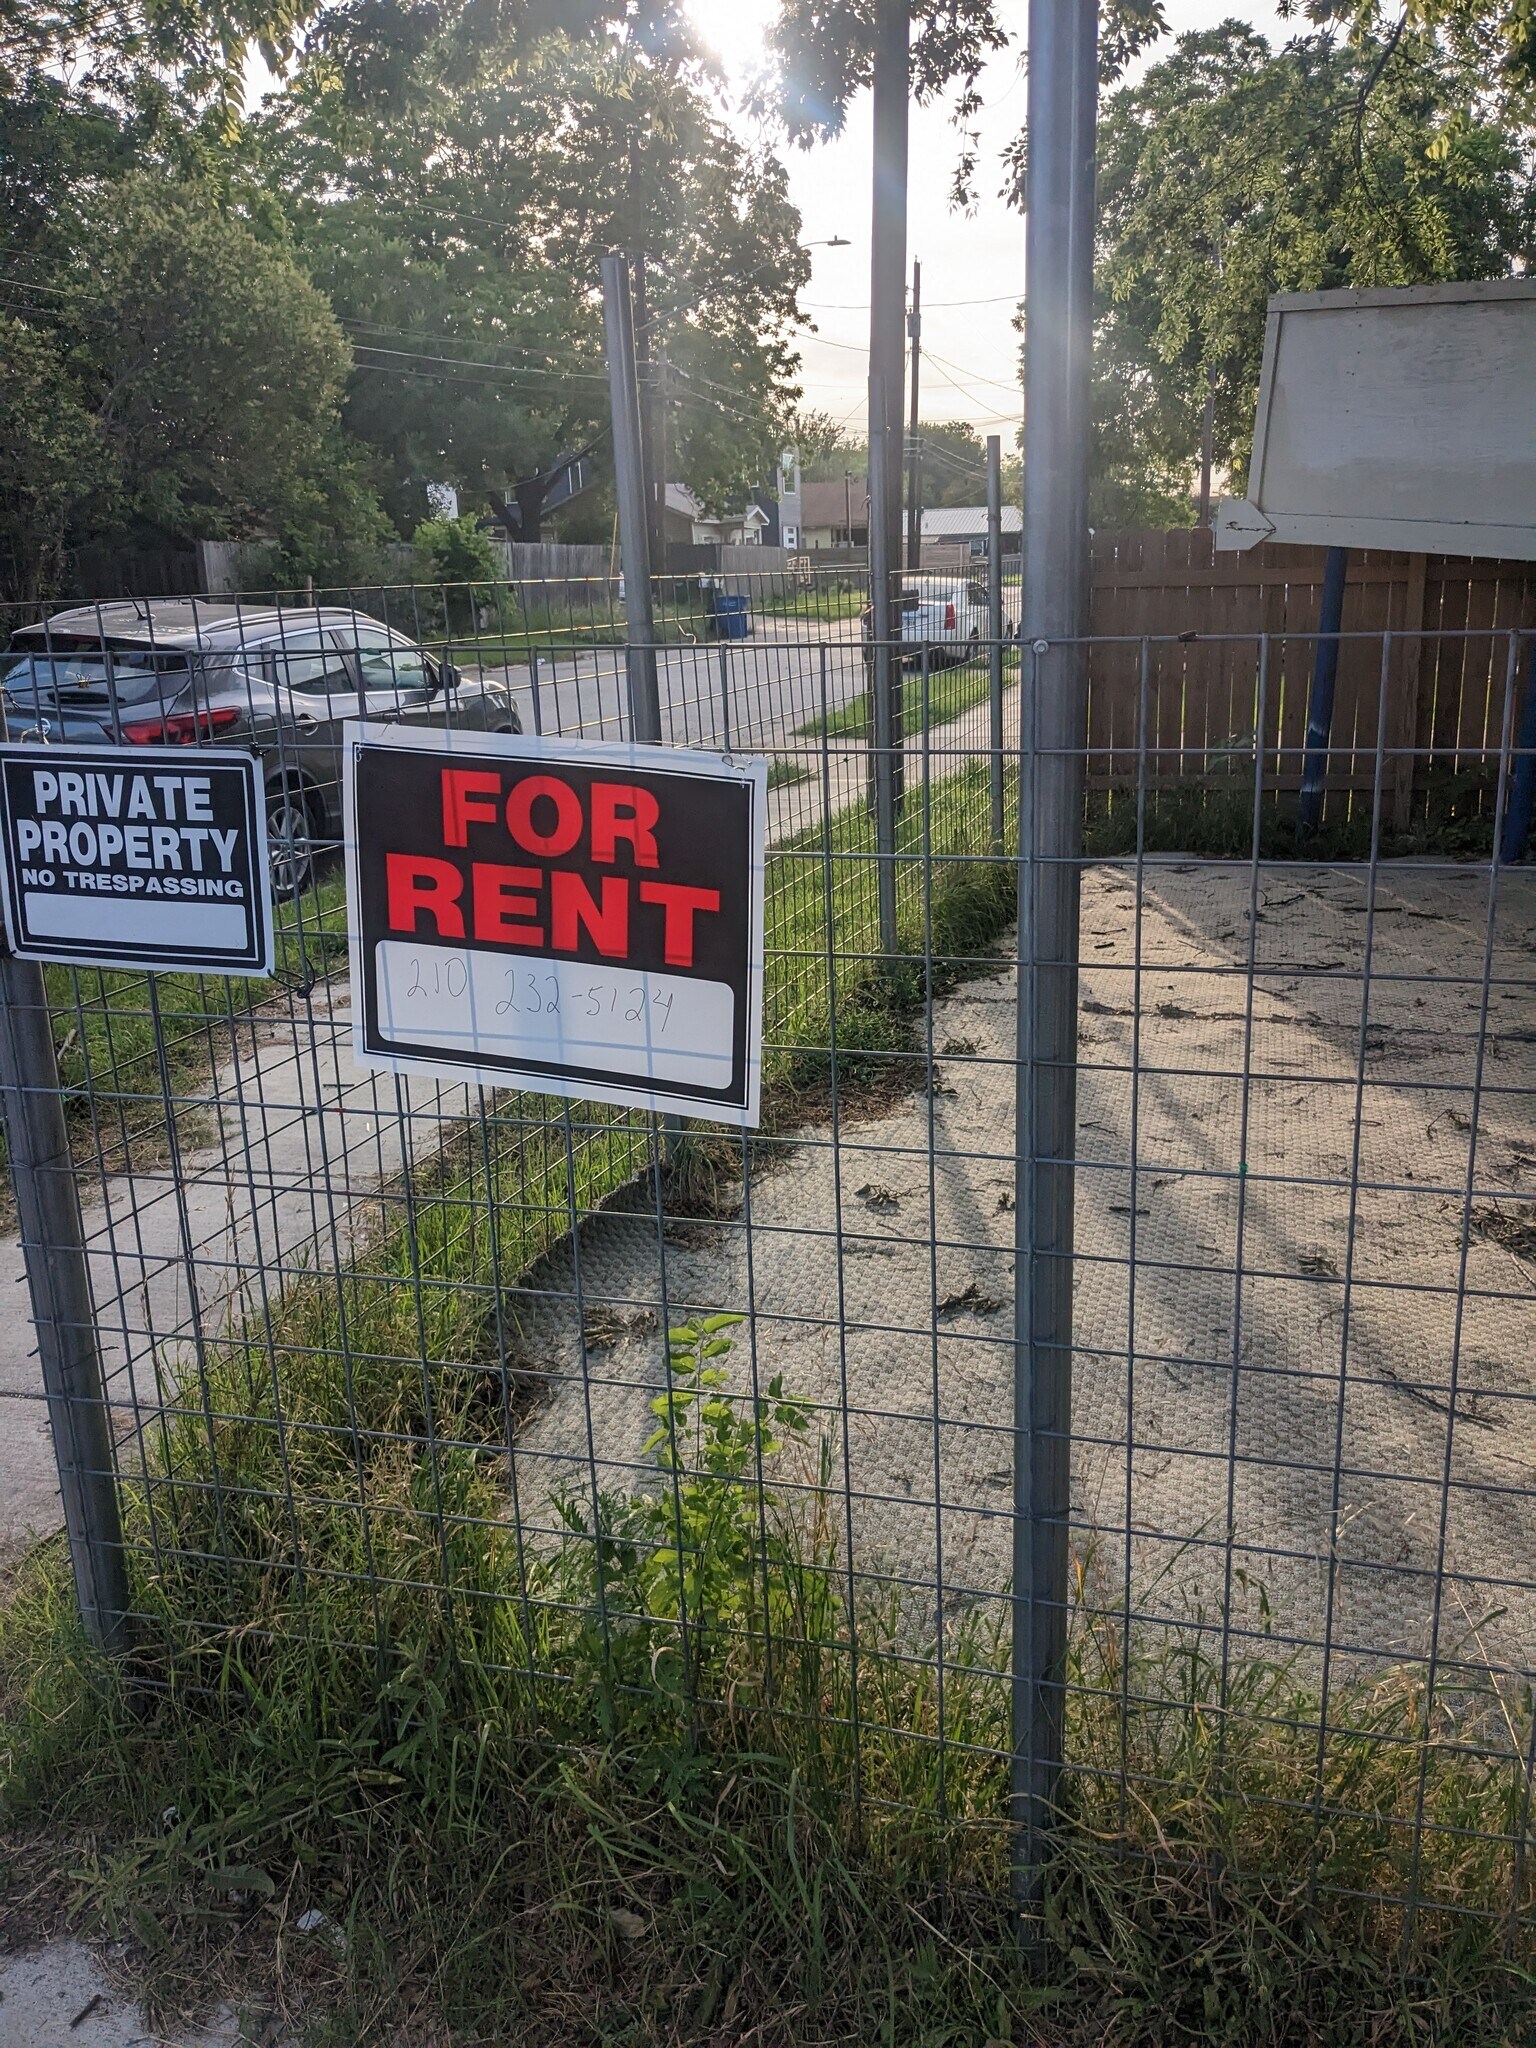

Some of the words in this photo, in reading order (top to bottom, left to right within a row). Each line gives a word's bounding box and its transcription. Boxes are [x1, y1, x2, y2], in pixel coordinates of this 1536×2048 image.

[33, 770, 214, 822] PRIVATE
[441, 768, 660, 869] FOR
[16, 818, 239, 873] PROPERTY
[22, 868, 56, 887] NO
[63, 871, 244, 897] TRESPASSING
[386, 852, 720, 968] RENT
[407, 957, 468, 997] 210
